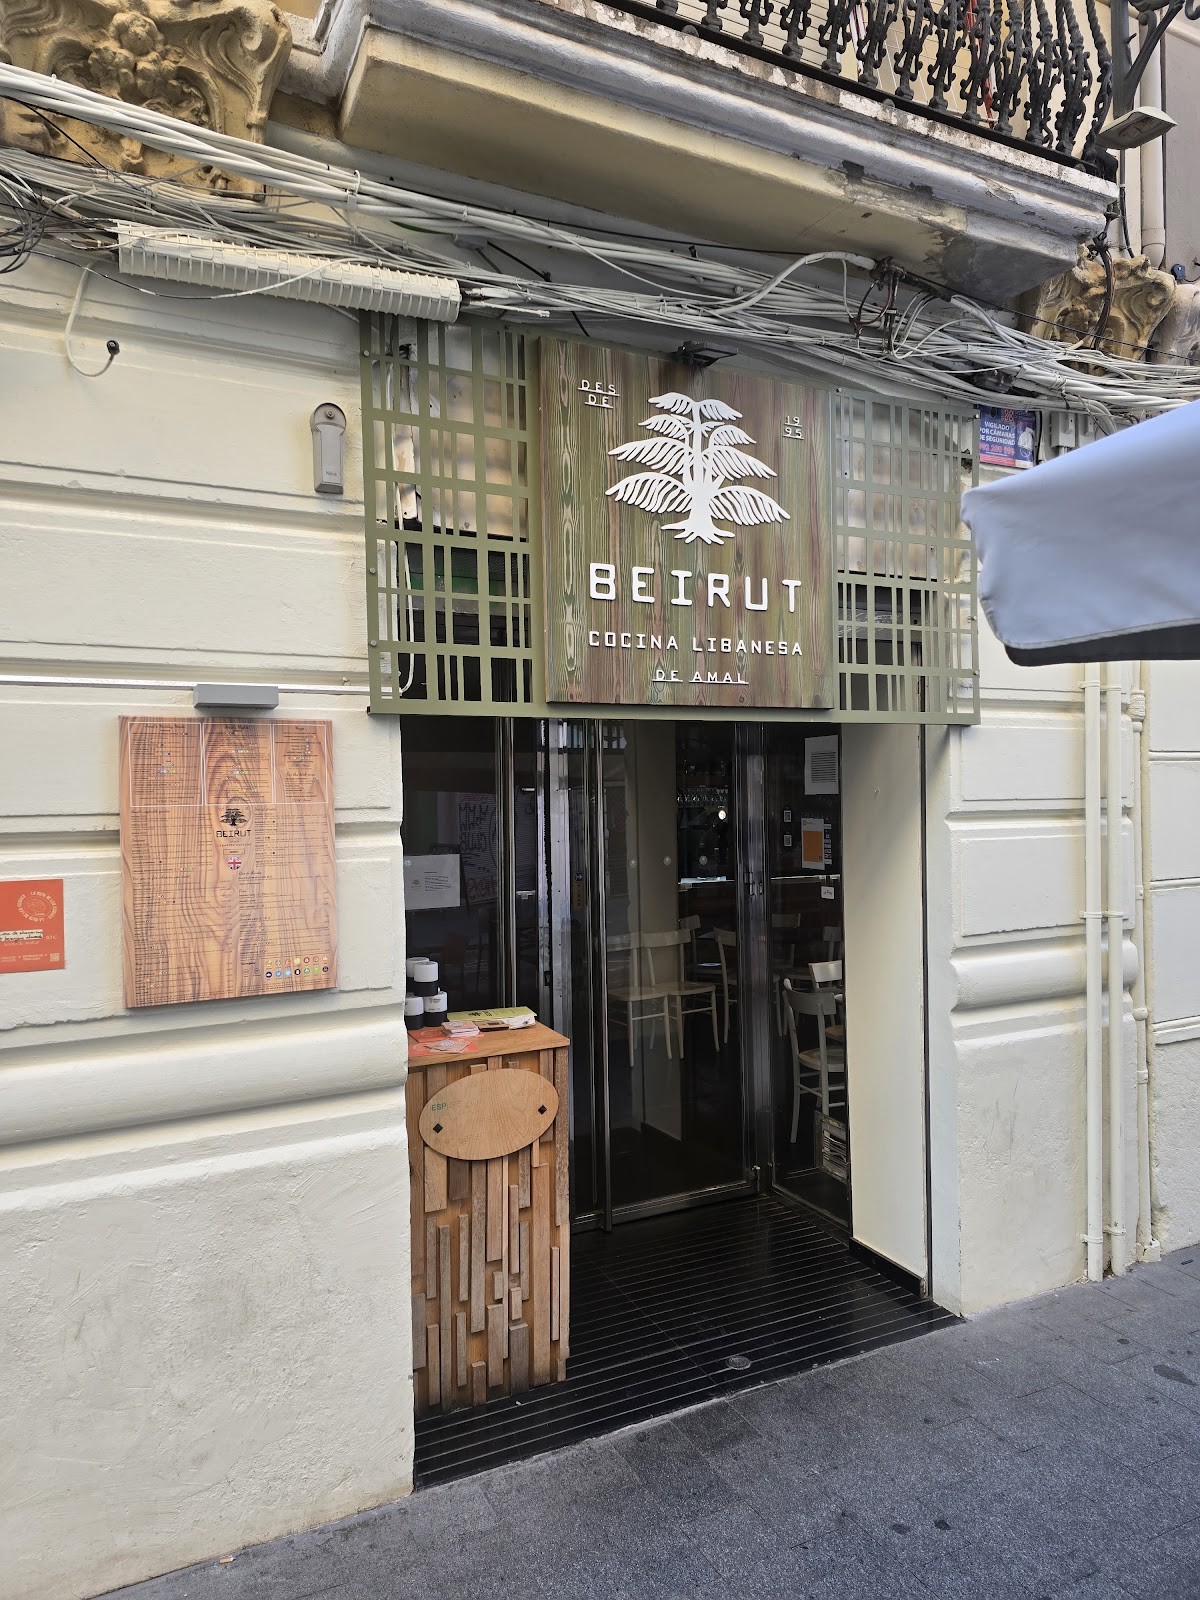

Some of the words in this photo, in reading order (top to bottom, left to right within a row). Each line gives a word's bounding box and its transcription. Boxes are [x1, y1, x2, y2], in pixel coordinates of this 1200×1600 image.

[581, 379, 617, 394] DES
[588, 393, 610, 406] DE
[785, 415, 800, 425] 19
[984, 421, 1010, 431] VIGILADO
[785, 427, 802, 438] 95
[986, 435, 1015, 445] SEGURIDAD
[589, 562, 802, 612] BEIRUT
[588, 630, 679, 650] COCINA
[692, 637, 803, 656] LIBANESA
[655, 669, 680, 682] DE
[691, 671, 747, 684] AMAL
[216, 829, 251, 837] BEIRUT
